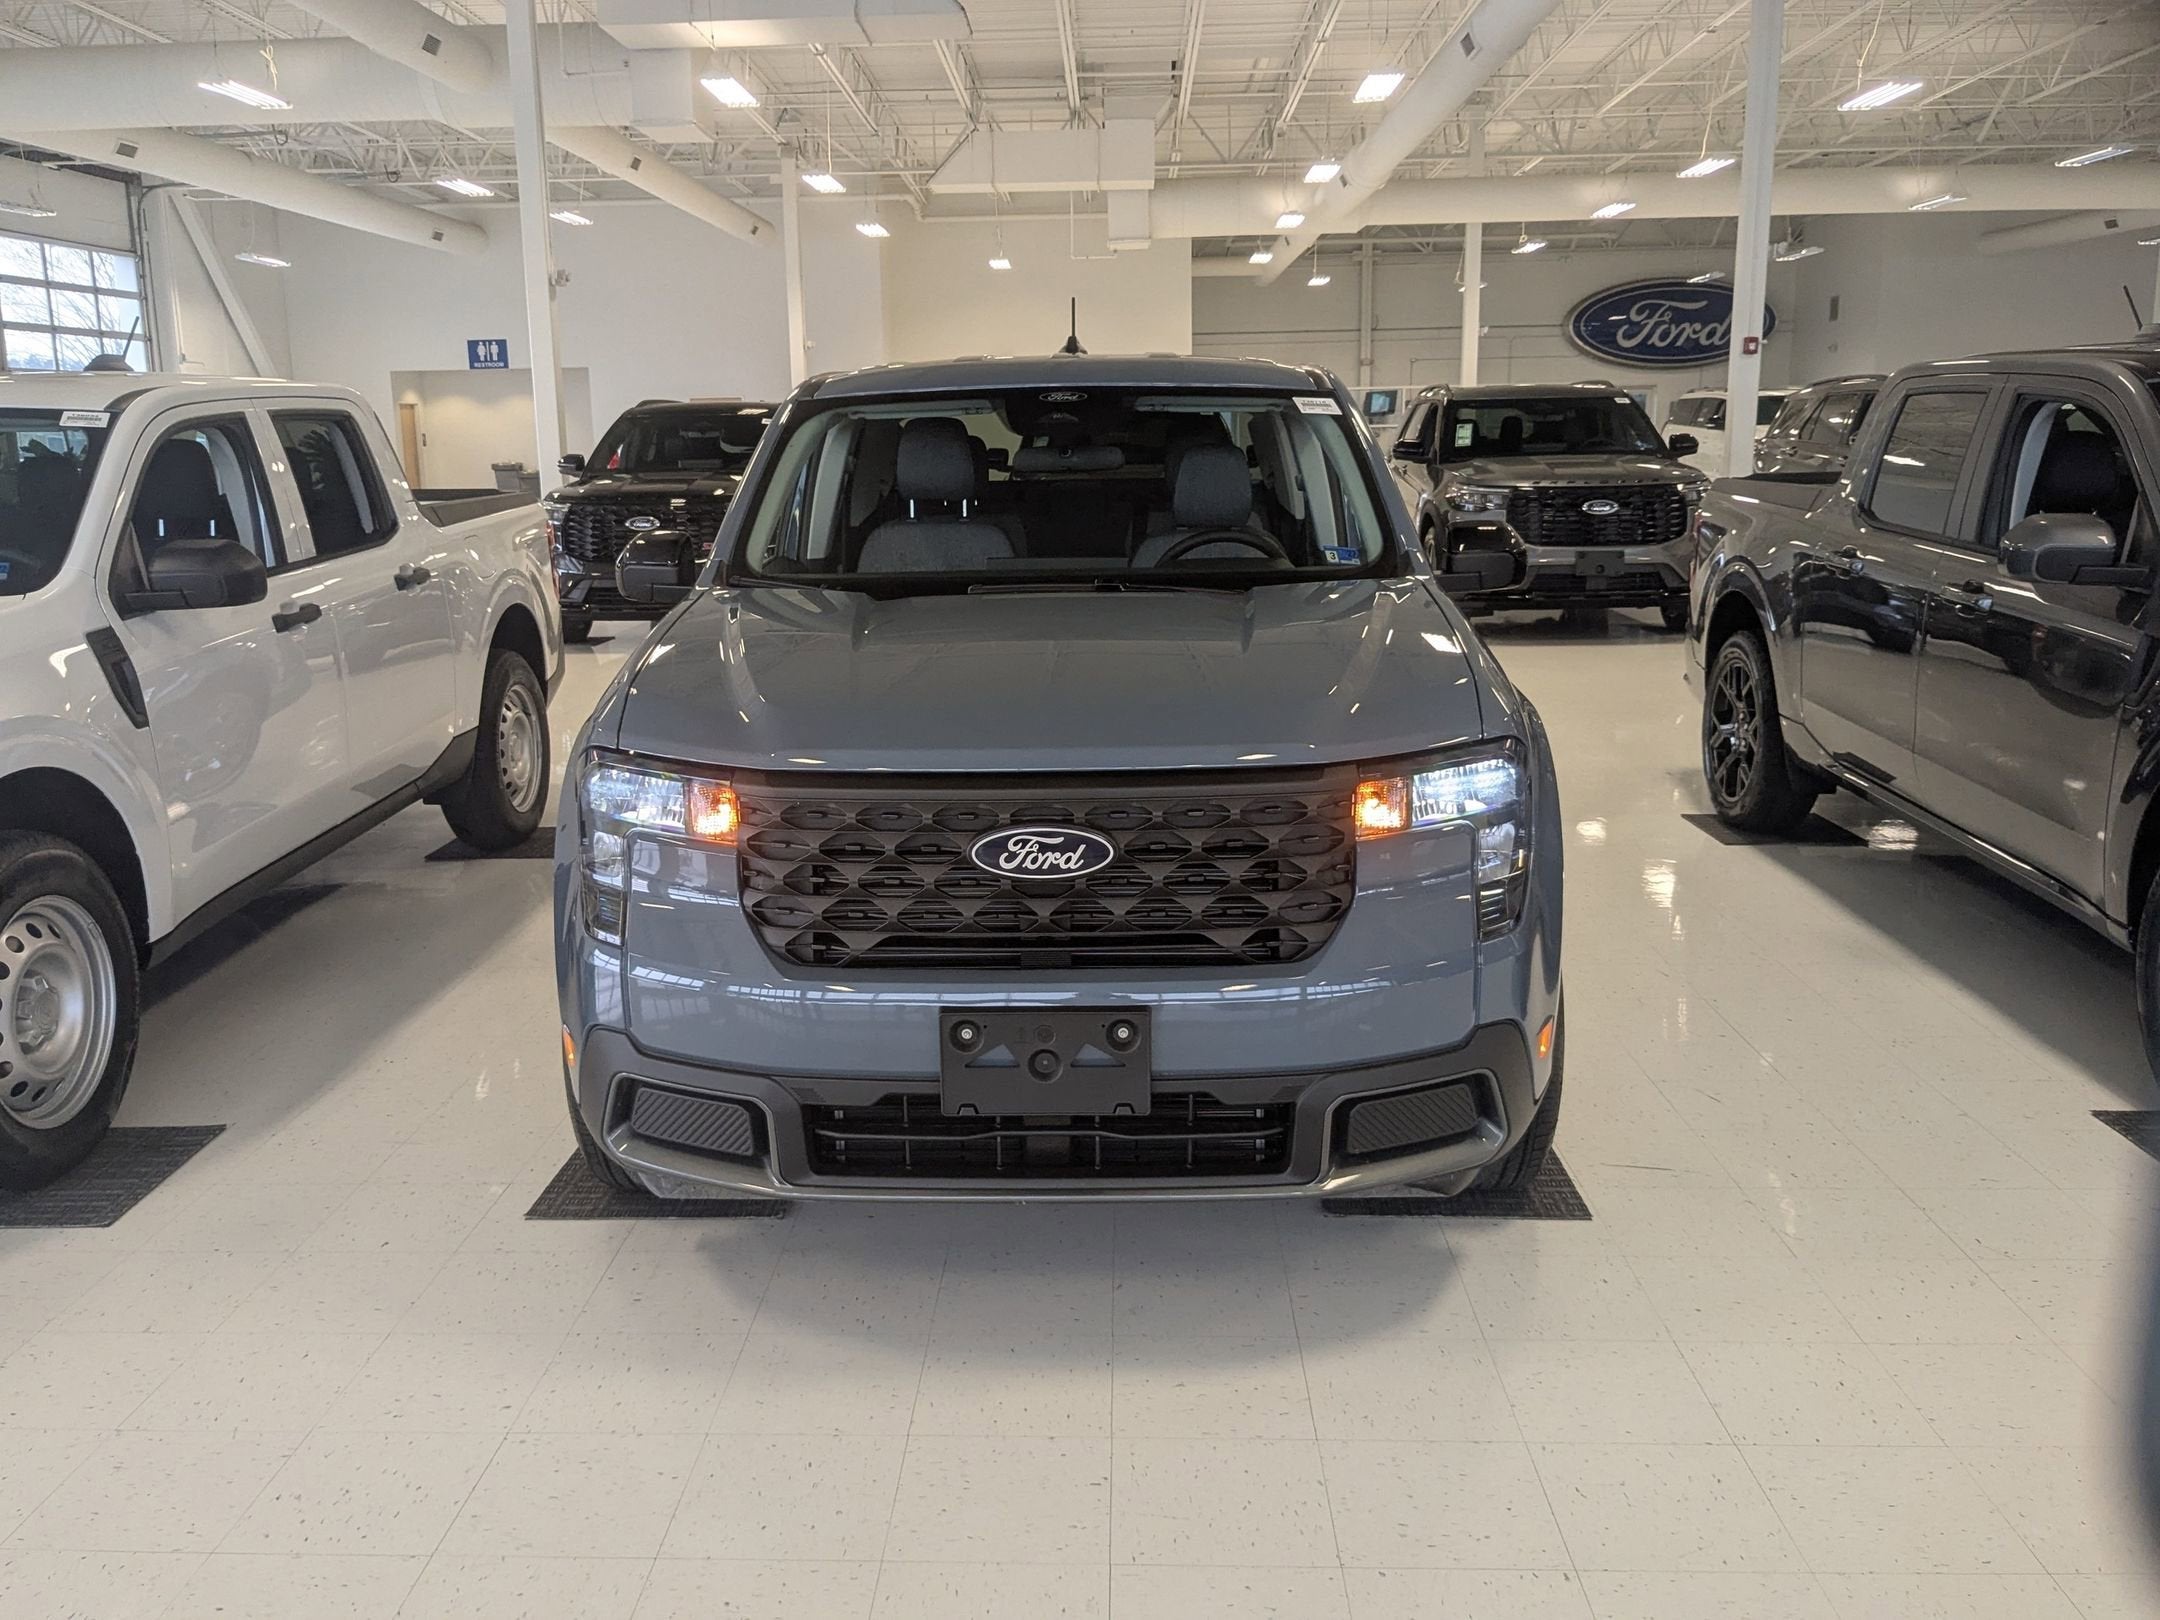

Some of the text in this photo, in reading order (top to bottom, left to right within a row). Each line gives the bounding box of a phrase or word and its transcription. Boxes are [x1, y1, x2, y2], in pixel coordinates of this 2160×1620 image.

[1616, 299, 1732, 348] Ford
[1047, 391, 1079, 401] Ford
[1330, 552, 1336, 560] 3
[999, 835, 1087, 870] Ford
